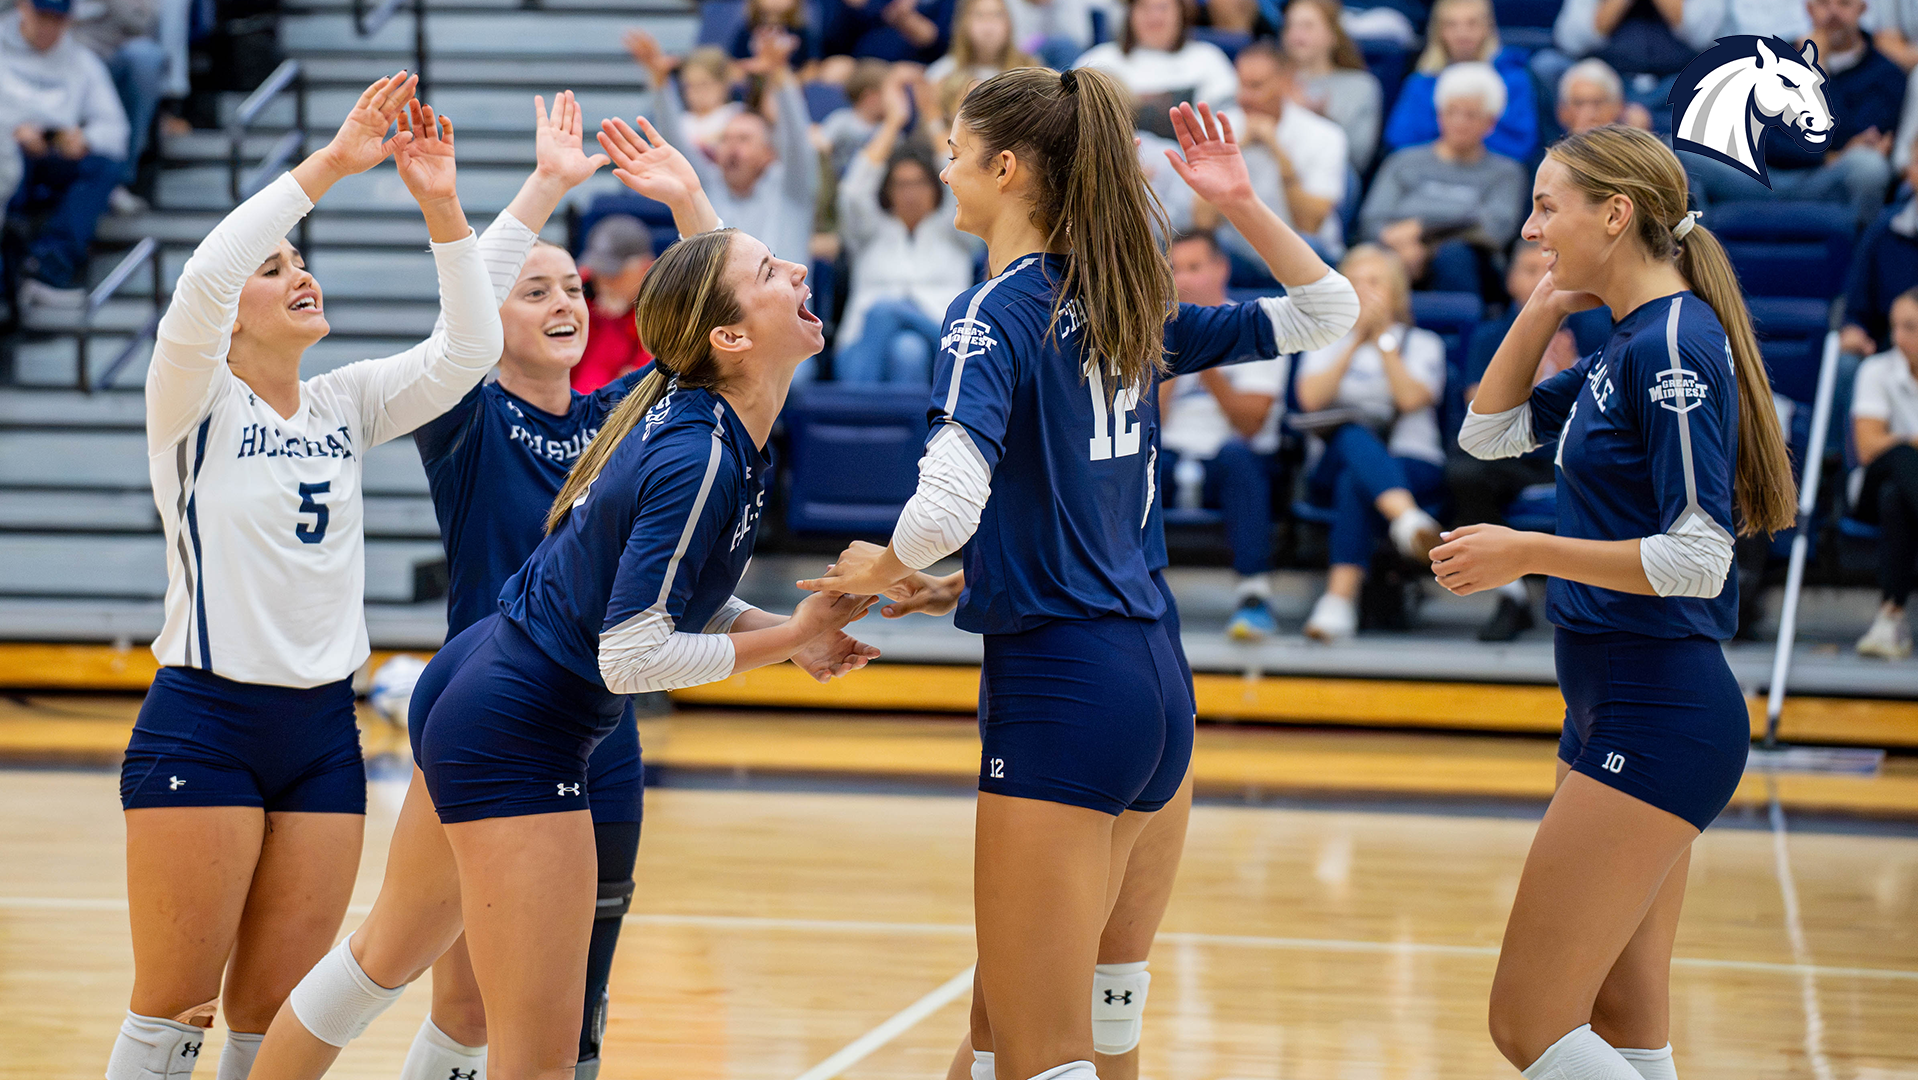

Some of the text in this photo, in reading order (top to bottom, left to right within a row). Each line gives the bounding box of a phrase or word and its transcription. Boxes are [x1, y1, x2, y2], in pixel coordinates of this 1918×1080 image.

[940, 333, 998, 351] MIDWEST
[952, 326, 985, 337] GREAT
[1648, 383, 1708, 403] MIDWEST
[1661, 378, 1696, 389] GREAT
[1083, 347, 1141, 461] 12
[296, 480, 332, 545] 5
[989, 757, 1005, 779] 12
[1601, 751, 1626, 774] 10
